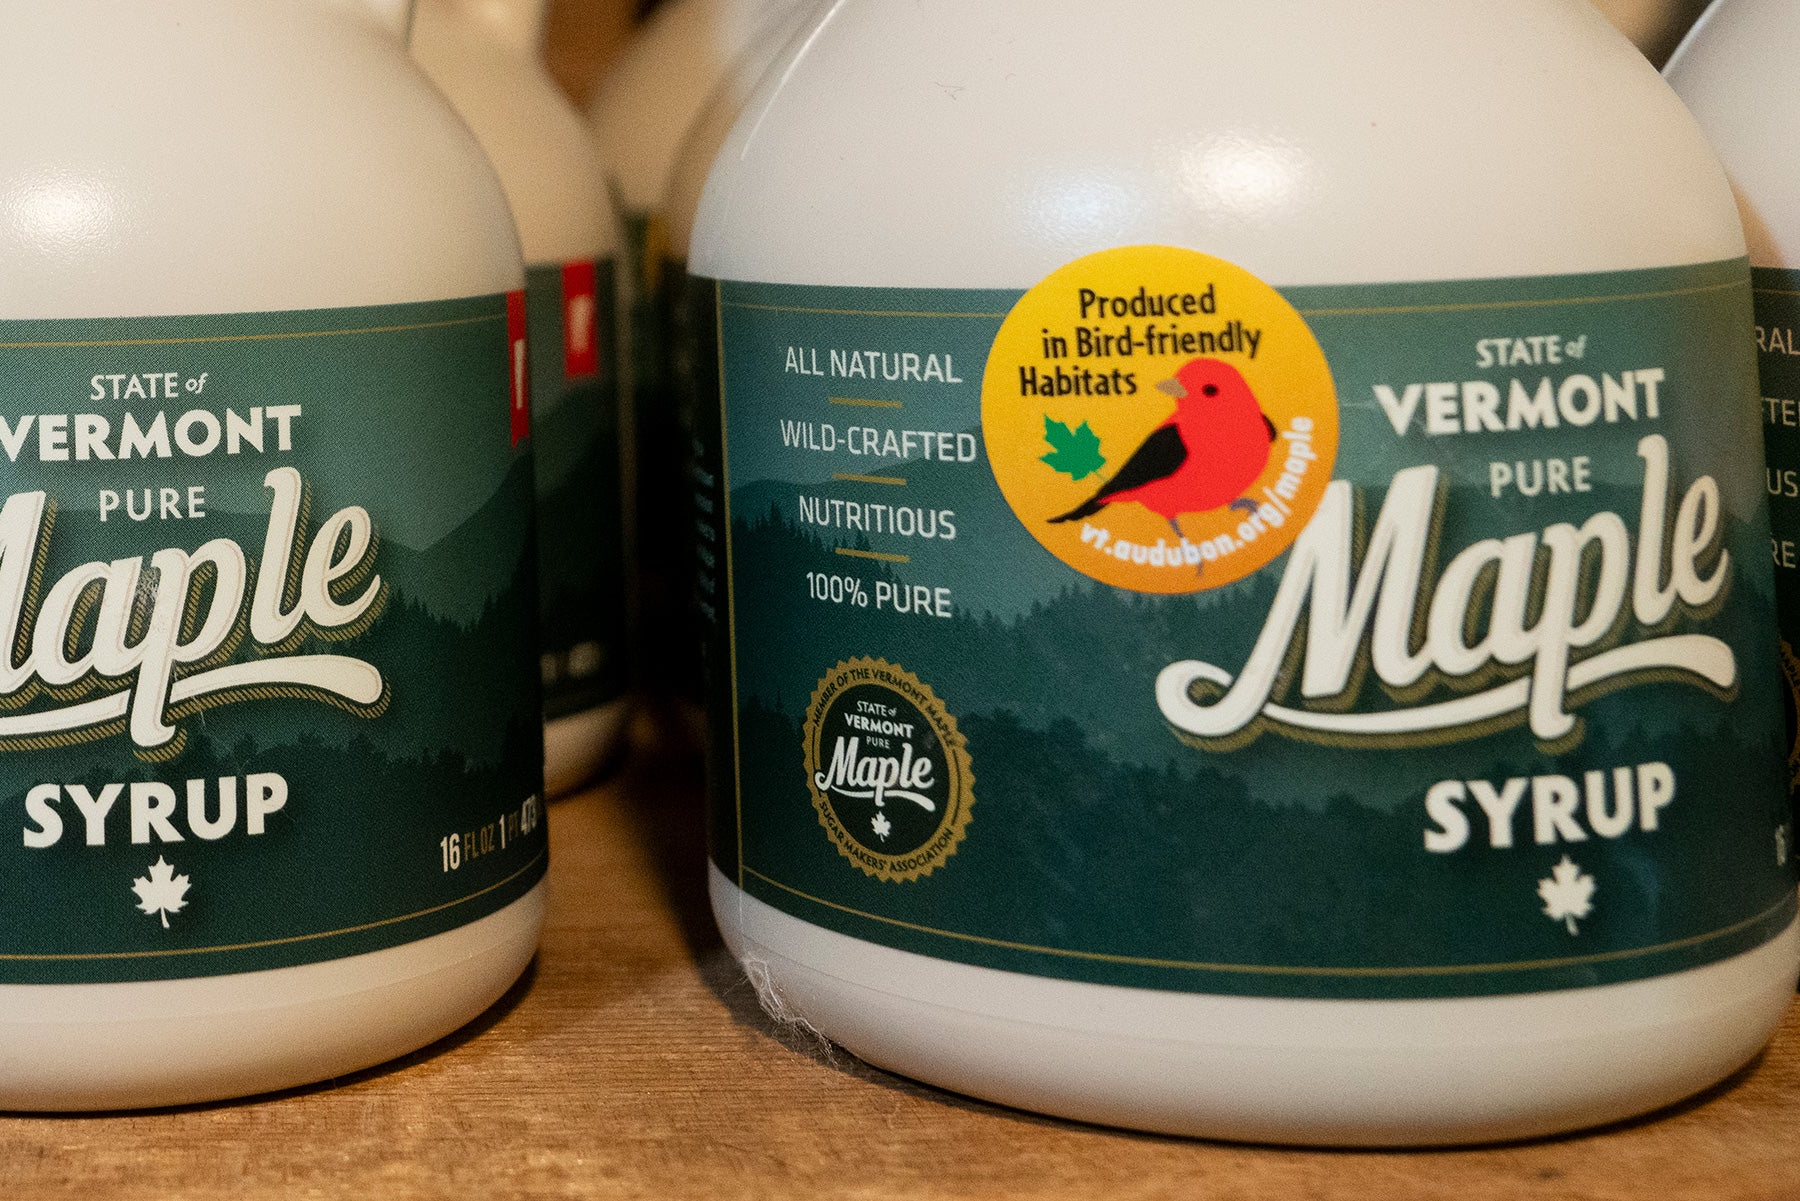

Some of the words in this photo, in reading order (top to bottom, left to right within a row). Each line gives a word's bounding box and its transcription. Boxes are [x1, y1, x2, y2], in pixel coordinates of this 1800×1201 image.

[1078, 283, 1215, 319] Produced
[1043, 329, 1067, 359] in
[1074, 322, 1261, 359] Bird-friendly
[1476, 336, 1562, 368] STATE
[1564, 335, 1587, 360] of
[90, 372, 179, 401] STATE
[185, 371, 209, 394] of
[784, 345, 824, 377] ALL
[829, 348, 962, 384] NATURAL
[1018, 365, 1137, 398] Habitats
[1372, 368, 1665, 435] VERMONT
[780, 419, 976, 463] WILD-CRAFTED
[1081, 416, 1319, 567] vt.audubon.org/maple
[1489, 456, 1591, 498] PURE
[100, 486, 206, 523] PURE
[799, 495, 956, 541] NUTRITIOUS
[806, 571, 868, 609] 100%
[875, 581, 952, 619] PURE
[1155, 434, 1736, 740] Maple
[813, 683, 838, 727] MEMBER
[836, 671, 849, 687] OF
[849, 668, 870, 682] THE
[871, 668, 928, 705] VERMONT
[857, 700, 887, 716] STATE
[888, 707, 897, 717] of
[844, 712, 914, 738] VERMONT
[866, 736, 890, 749] PURE
[815, 736, 936, 812] Maple
[23, 771, 289, 849] SYRUP
[1423, 762, 1676, 852] SYRUP
[440, 832, 460, 873] 16
[499, 813, 506, 850] 1
[818, 801, 844, 843] SUGAR
[888, 827, 954, 873] ASSOCIATION
